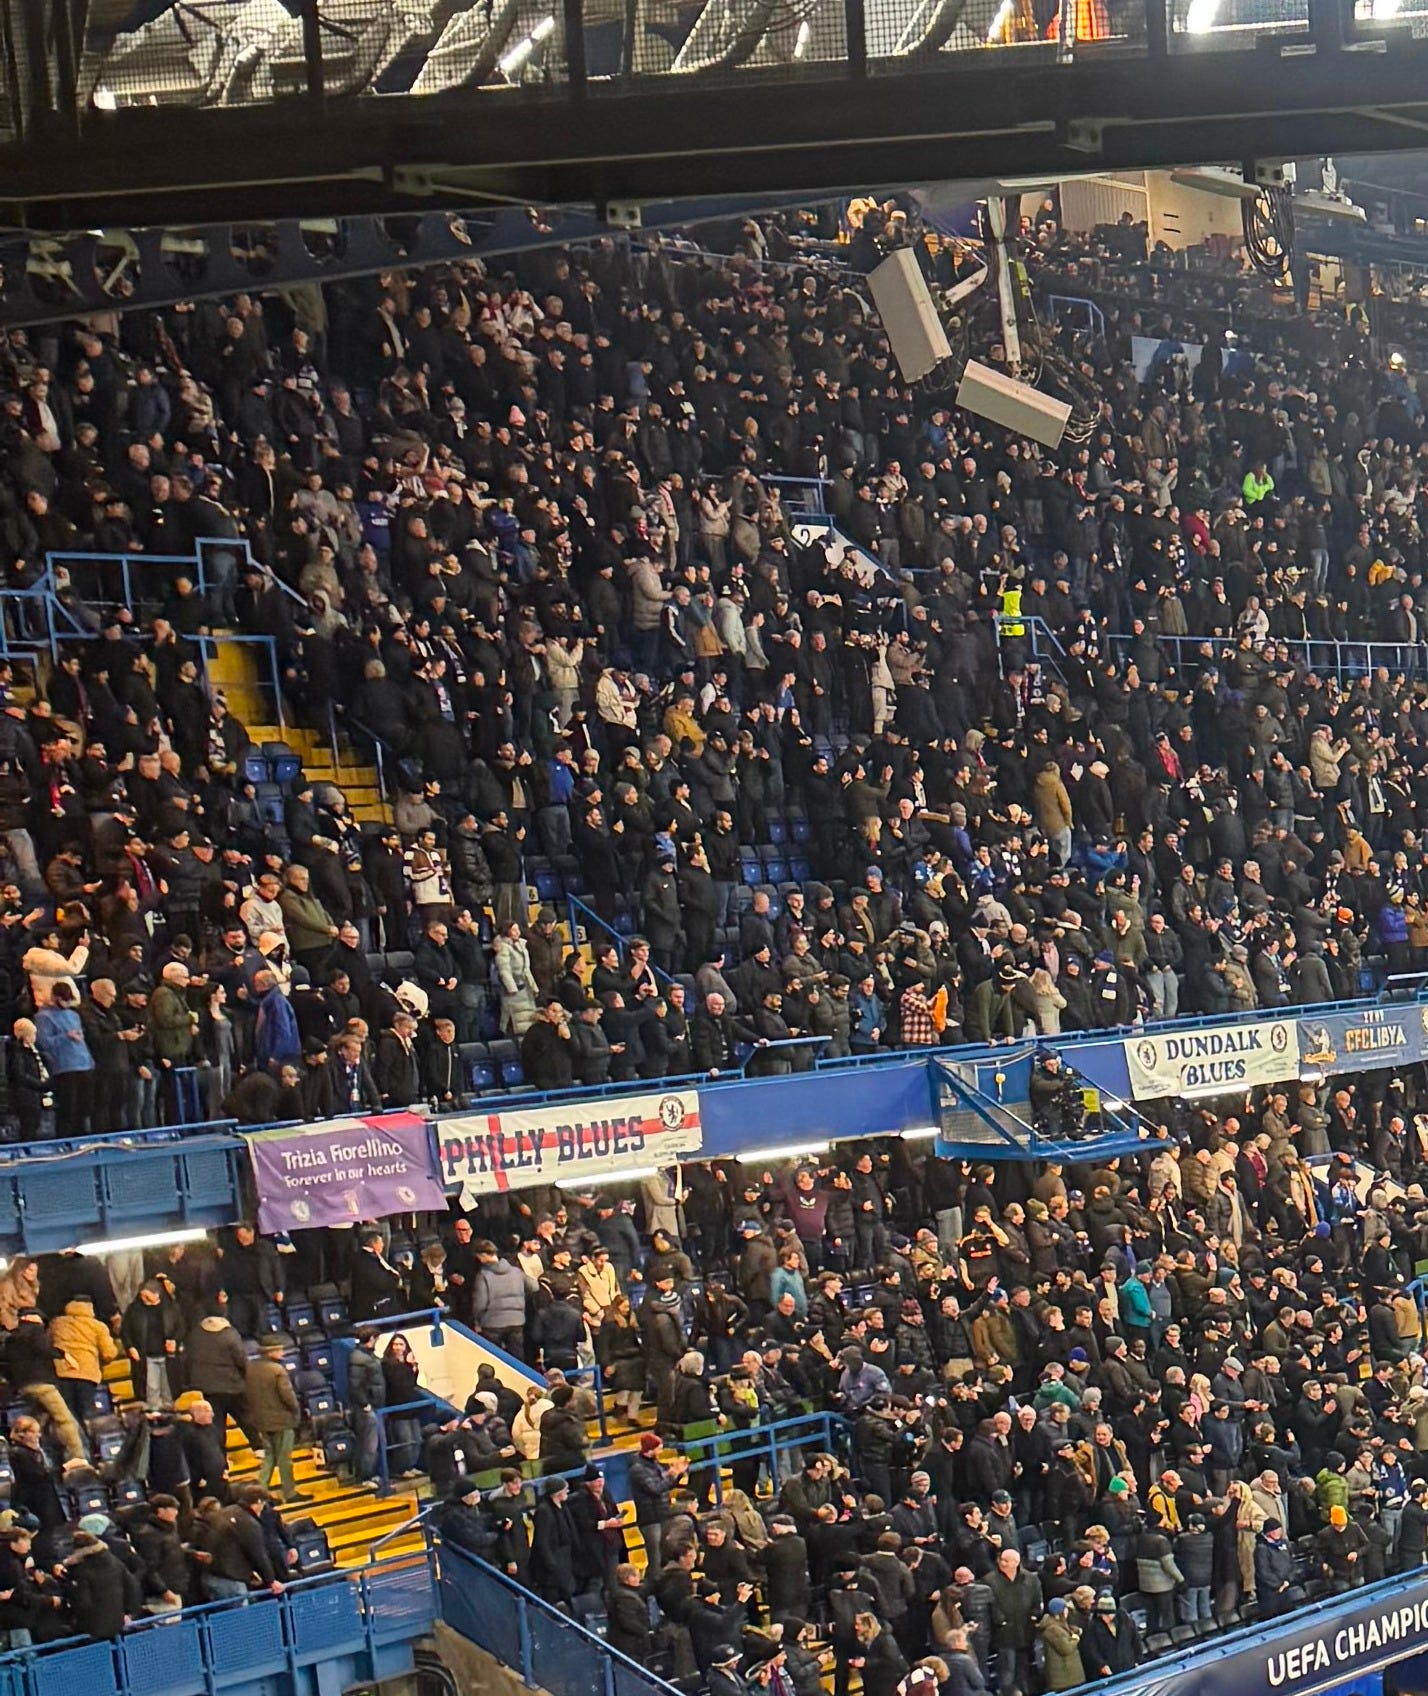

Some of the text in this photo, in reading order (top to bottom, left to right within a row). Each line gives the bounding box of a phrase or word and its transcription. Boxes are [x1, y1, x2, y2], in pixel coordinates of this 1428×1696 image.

[1165, 1029, 1263, 1060] DUNDALK
[1186, 1059, 1247, 1086] BLUES
[281, 1138, 403, 1170] Trizia Fiorellino
[444, 1128, 546, 1177] PHILLY
[555, 1116, 646, 1162] BLUES
[284, 1161, 407, 1188] Forever in our hearts
[1267, 1639, 1330, 1687] UEFA
